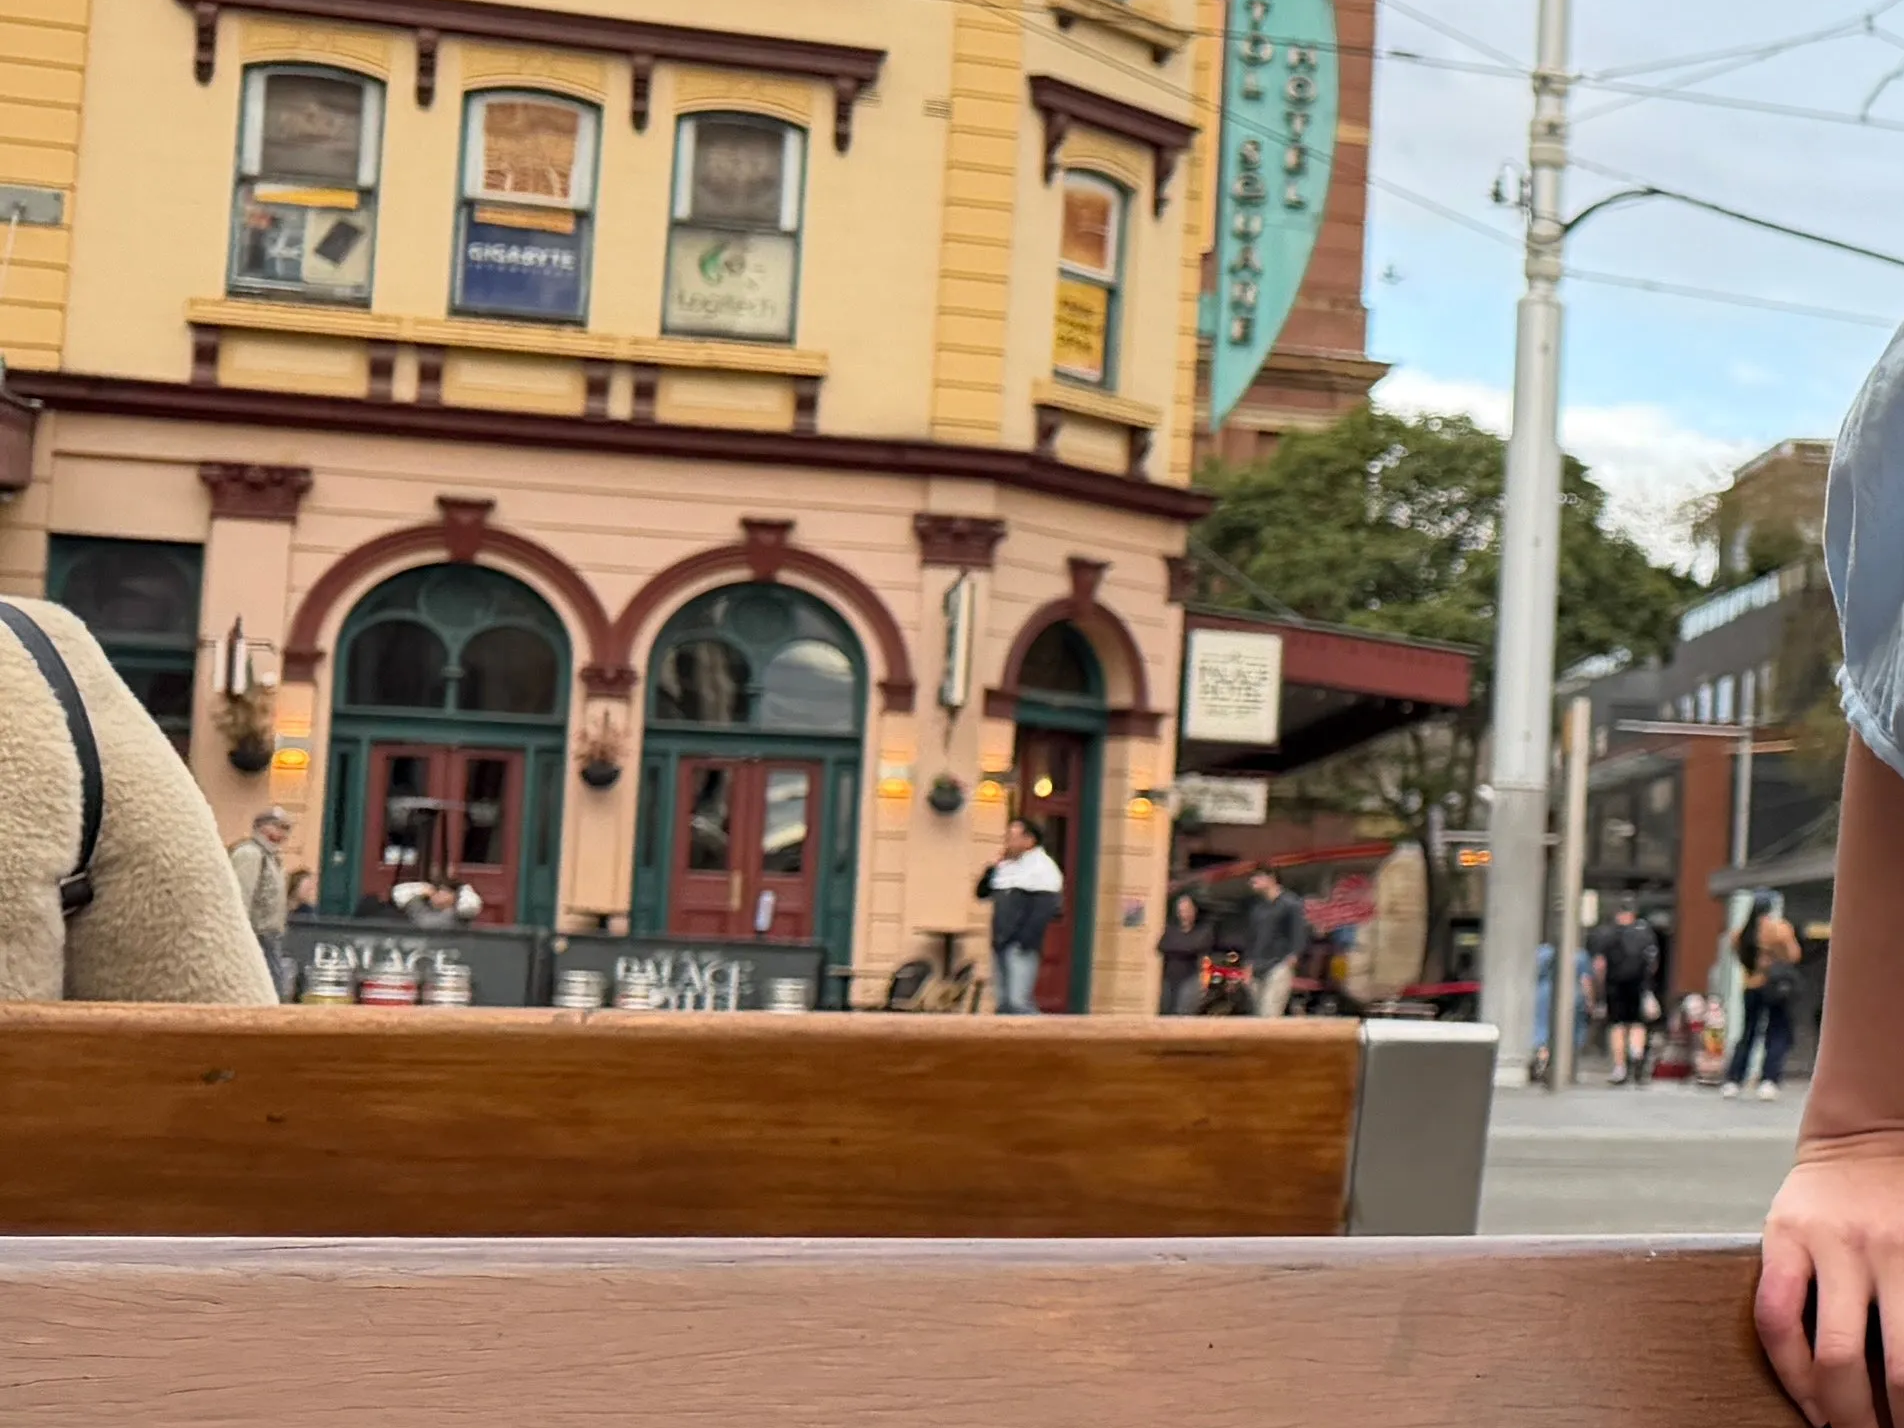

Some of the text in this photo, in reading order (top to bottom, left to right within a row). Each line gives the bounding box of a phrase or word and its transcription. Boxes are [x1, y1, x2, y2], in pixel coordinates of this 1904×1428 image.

[1283, 45, 1318, 210] HOTEL
[467, 242, 577, 271] GIGABYTE
[1228, 139, 1267, 347] SQUARE
